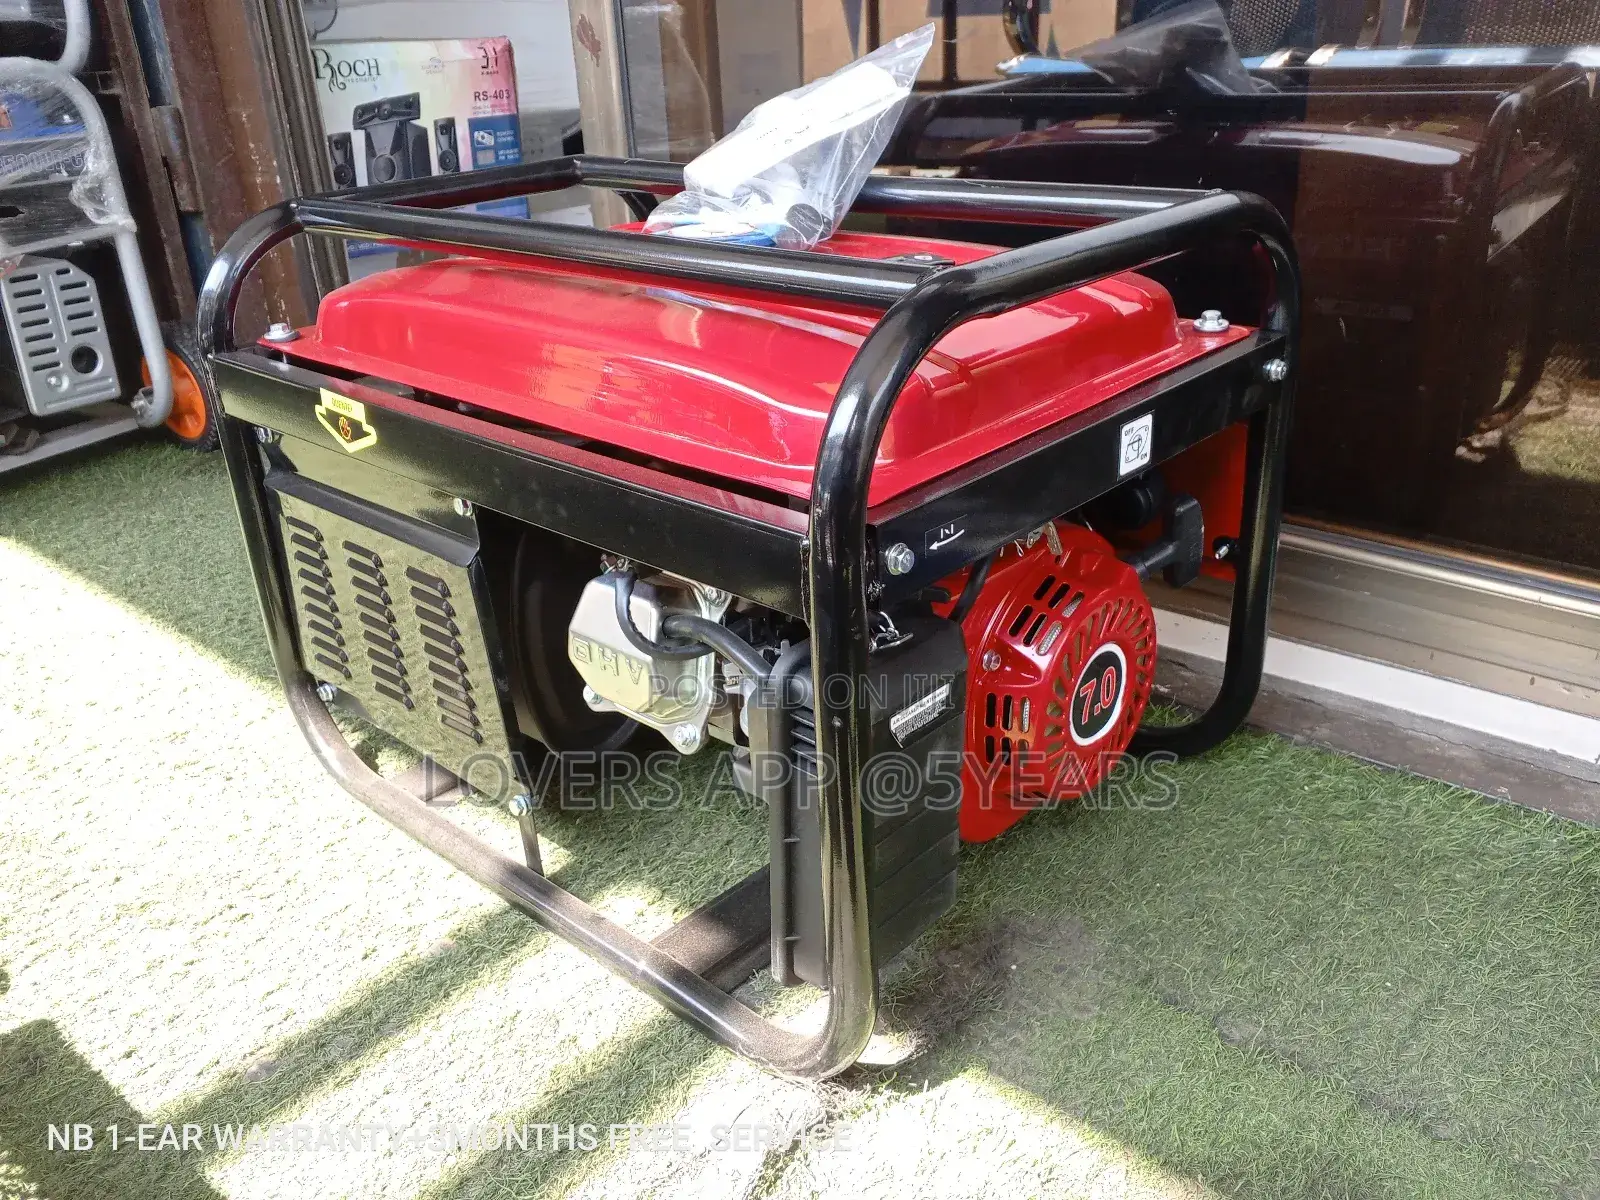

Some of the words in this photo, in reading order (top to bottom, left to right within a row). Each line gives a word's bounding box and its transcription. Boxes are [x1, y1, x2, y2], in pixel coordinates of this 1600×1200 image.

[474, 89, 511, 102] RS-403
[1124, 427, 1134, 436] OFF
[1080, 666, 1116, 725] 7.0
